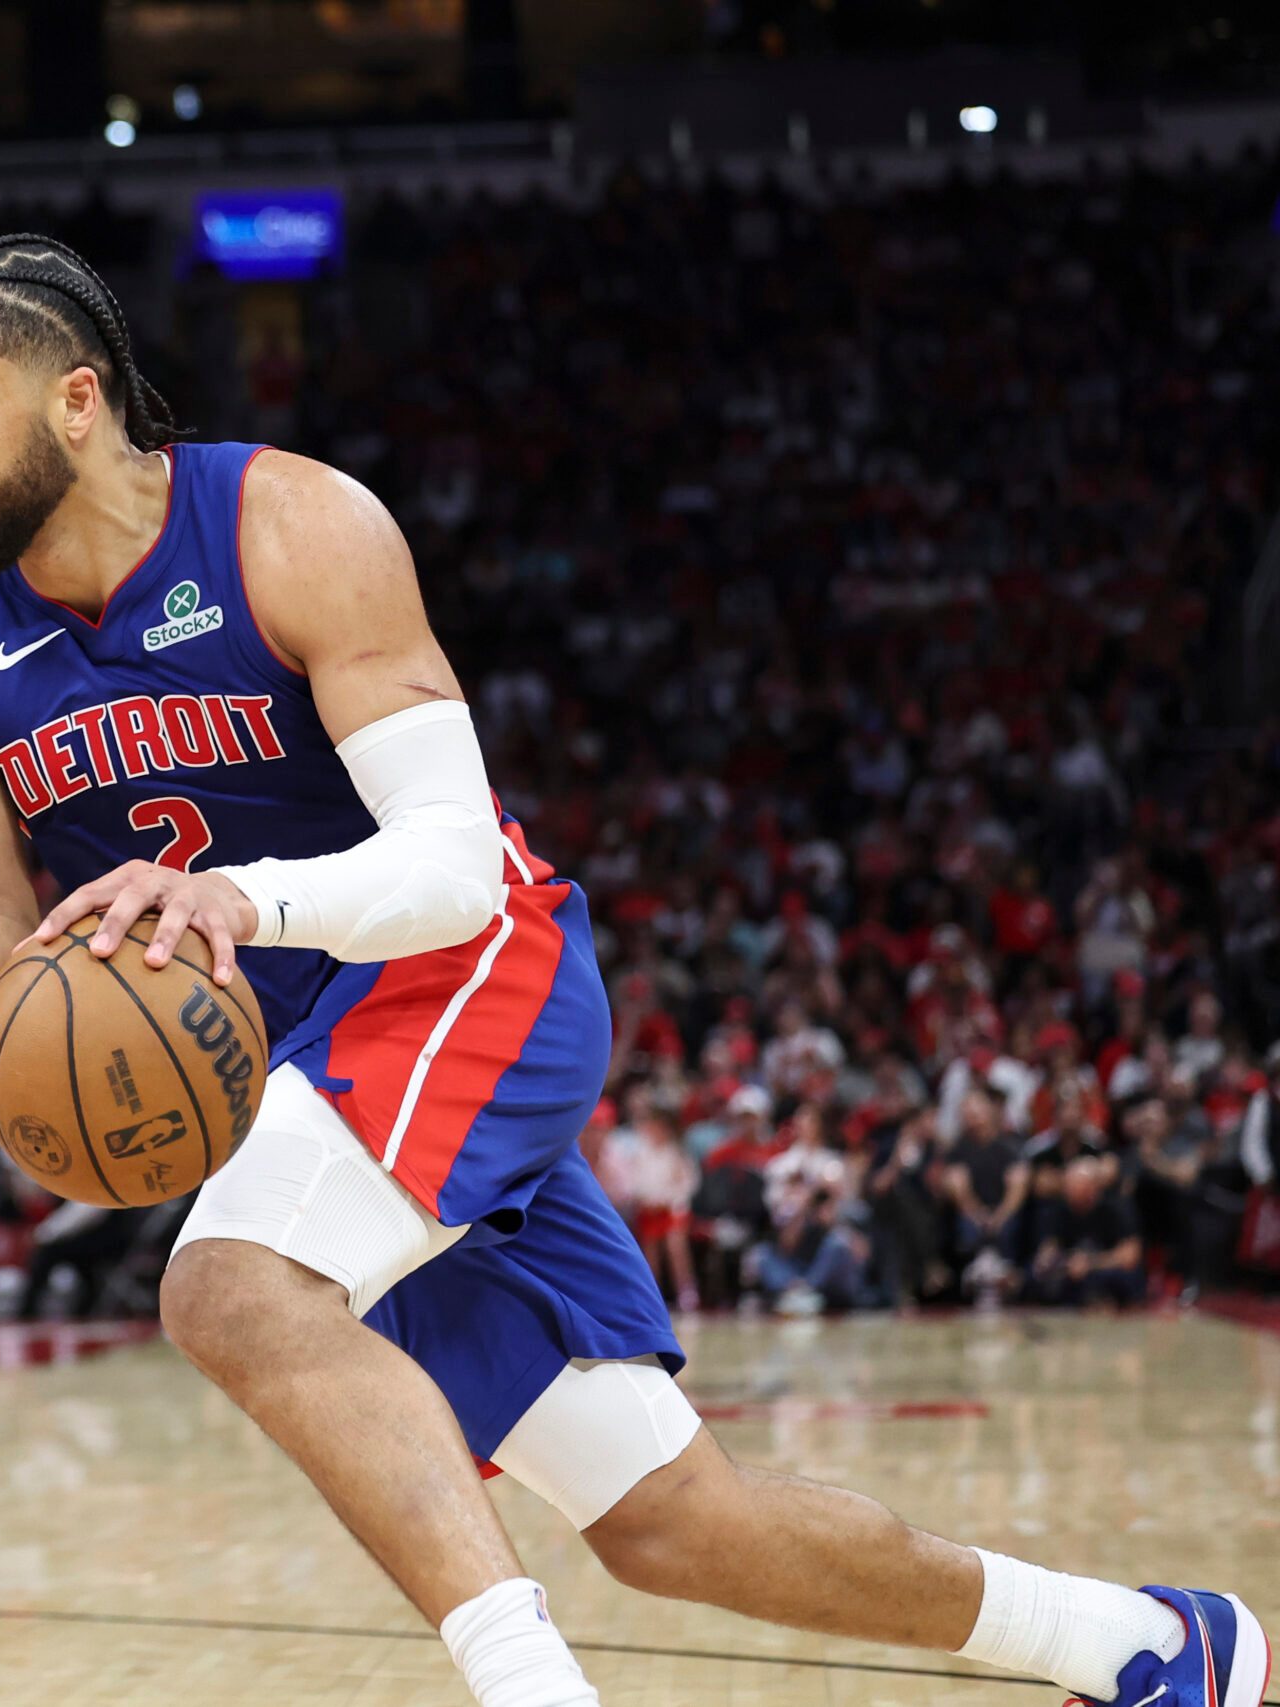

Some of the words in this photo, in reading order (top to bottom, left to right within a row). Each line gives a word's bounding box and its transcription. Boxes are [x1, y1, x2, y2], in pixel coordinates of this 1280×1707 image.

[146, 608, 220, 647] StockX
[128, 796, 212, 874] 2
[177, 980, 253, 1155] Wilso
